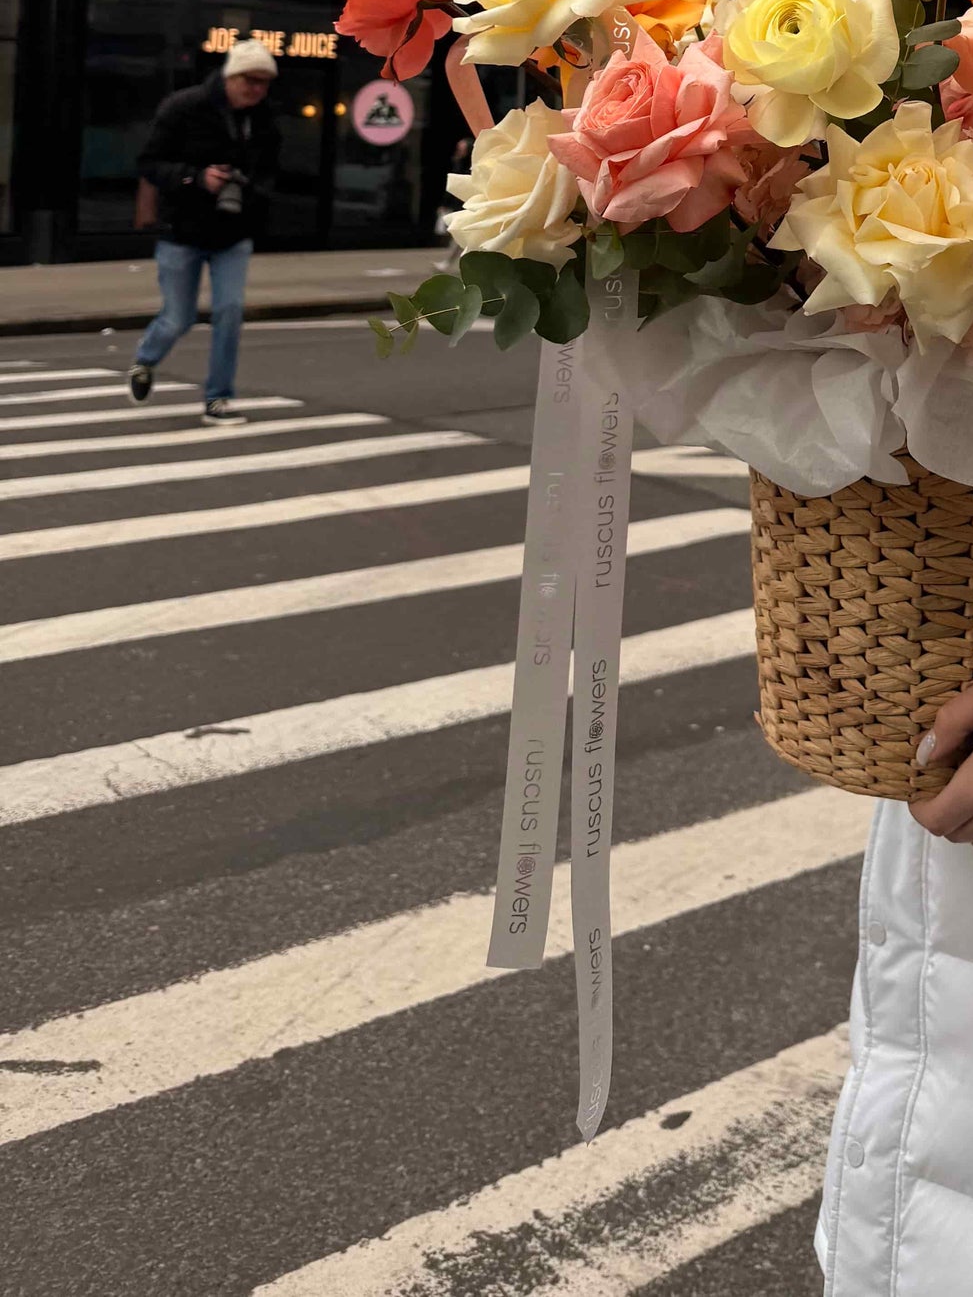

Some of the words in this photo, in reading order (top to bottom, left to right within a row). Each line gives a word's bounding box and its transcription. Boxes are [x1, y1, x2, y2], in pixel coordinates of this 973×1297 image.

[286, 31, 339, 59] JUICE
[595, 494, 615, 589] ruscus
[584, 658, 608, 754] flowers
[520, 738, 545, 832] ruscus
[586, 762, 603, 858] ruscus
[508, 842, 543, 935] flowers
